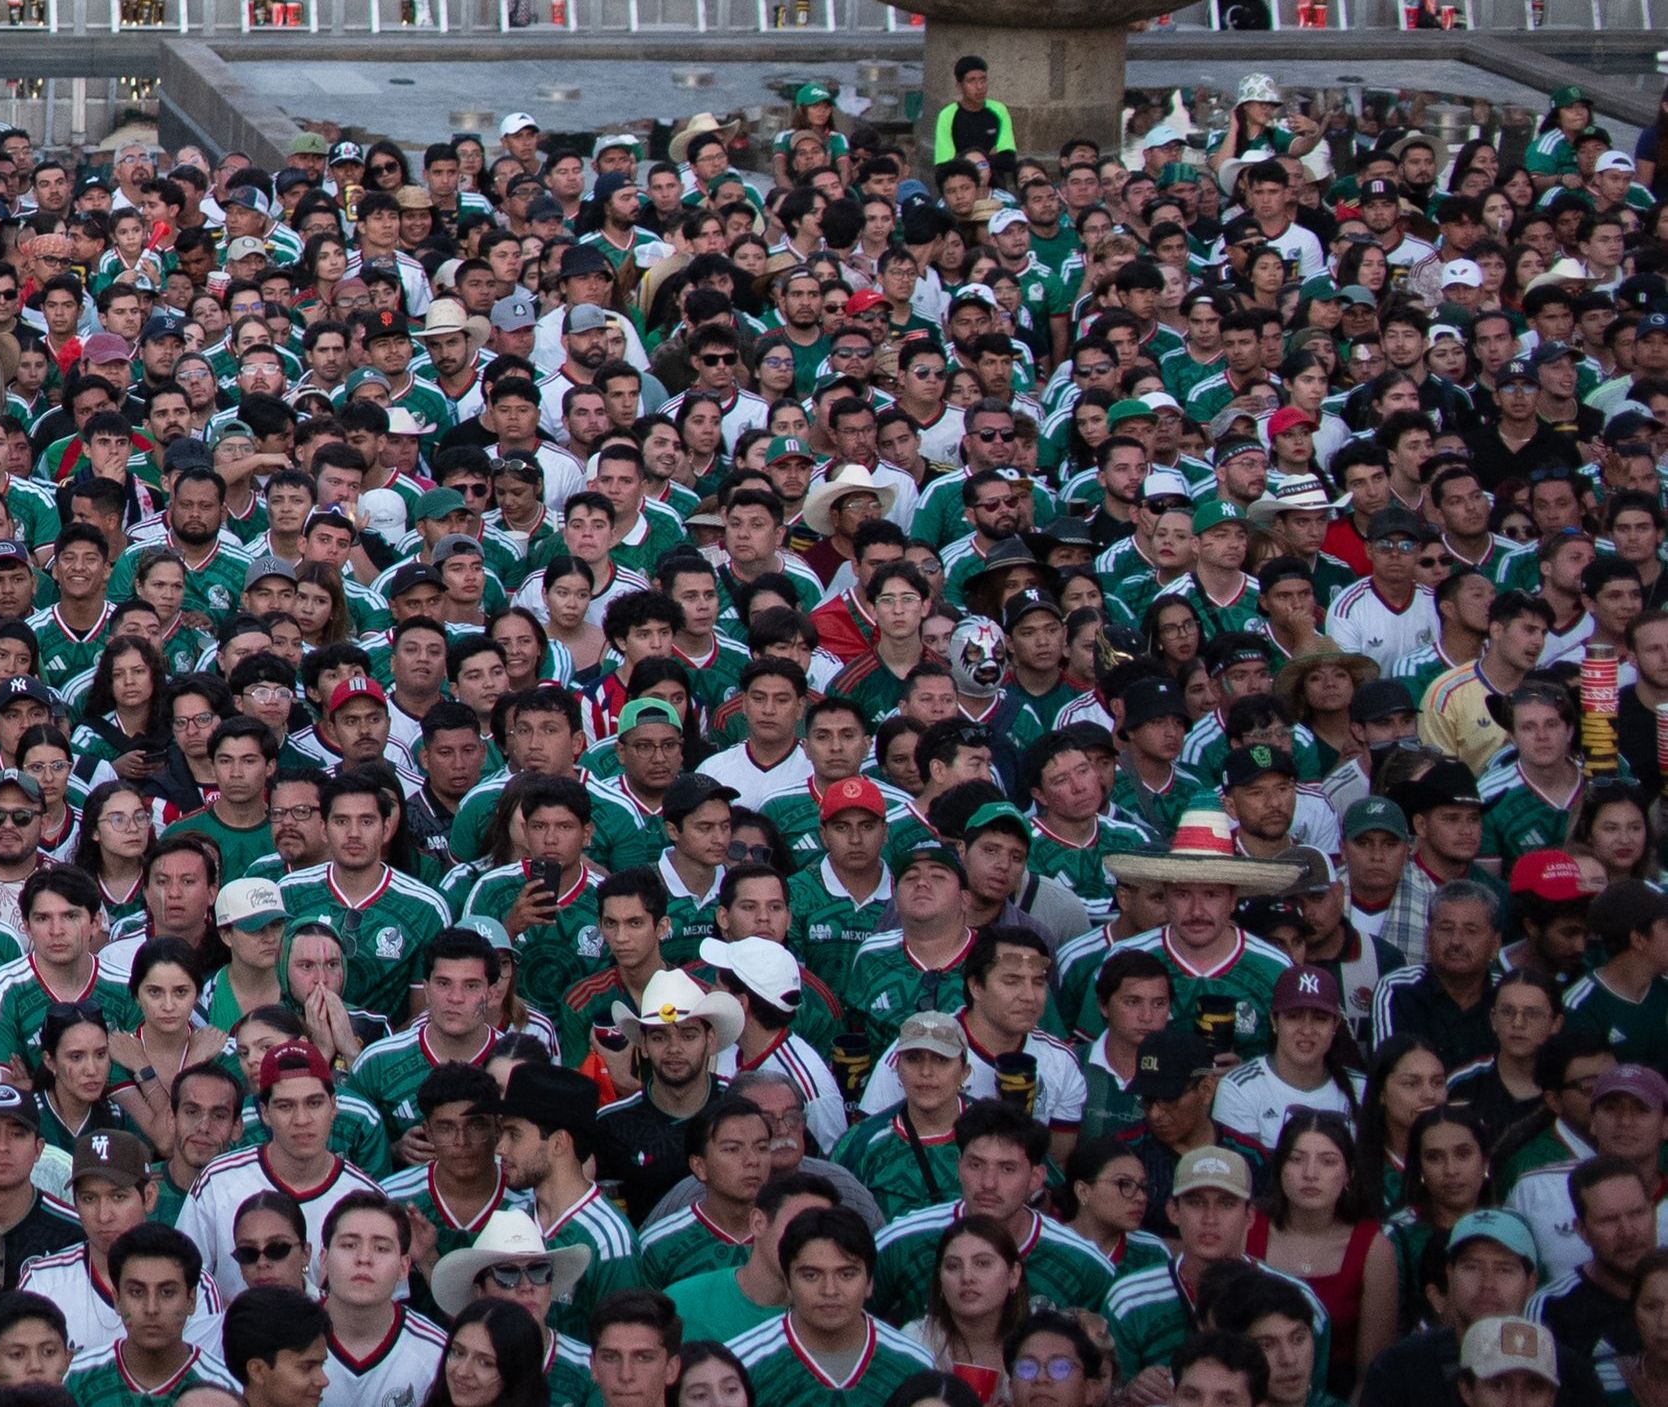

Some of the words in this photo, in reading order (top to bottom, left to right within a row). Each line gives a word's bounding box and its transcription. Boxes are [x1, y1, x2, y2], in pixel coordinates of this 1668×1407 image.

[380, 310, 392, 327] SF
[1220, 502, 1236, 518] NY
[10, 678, 28, 693] NY
[475, 922, 493, 938] LA
[809, 924, 832, 933] ABA
[1299, 973, 1320, 994] NY
